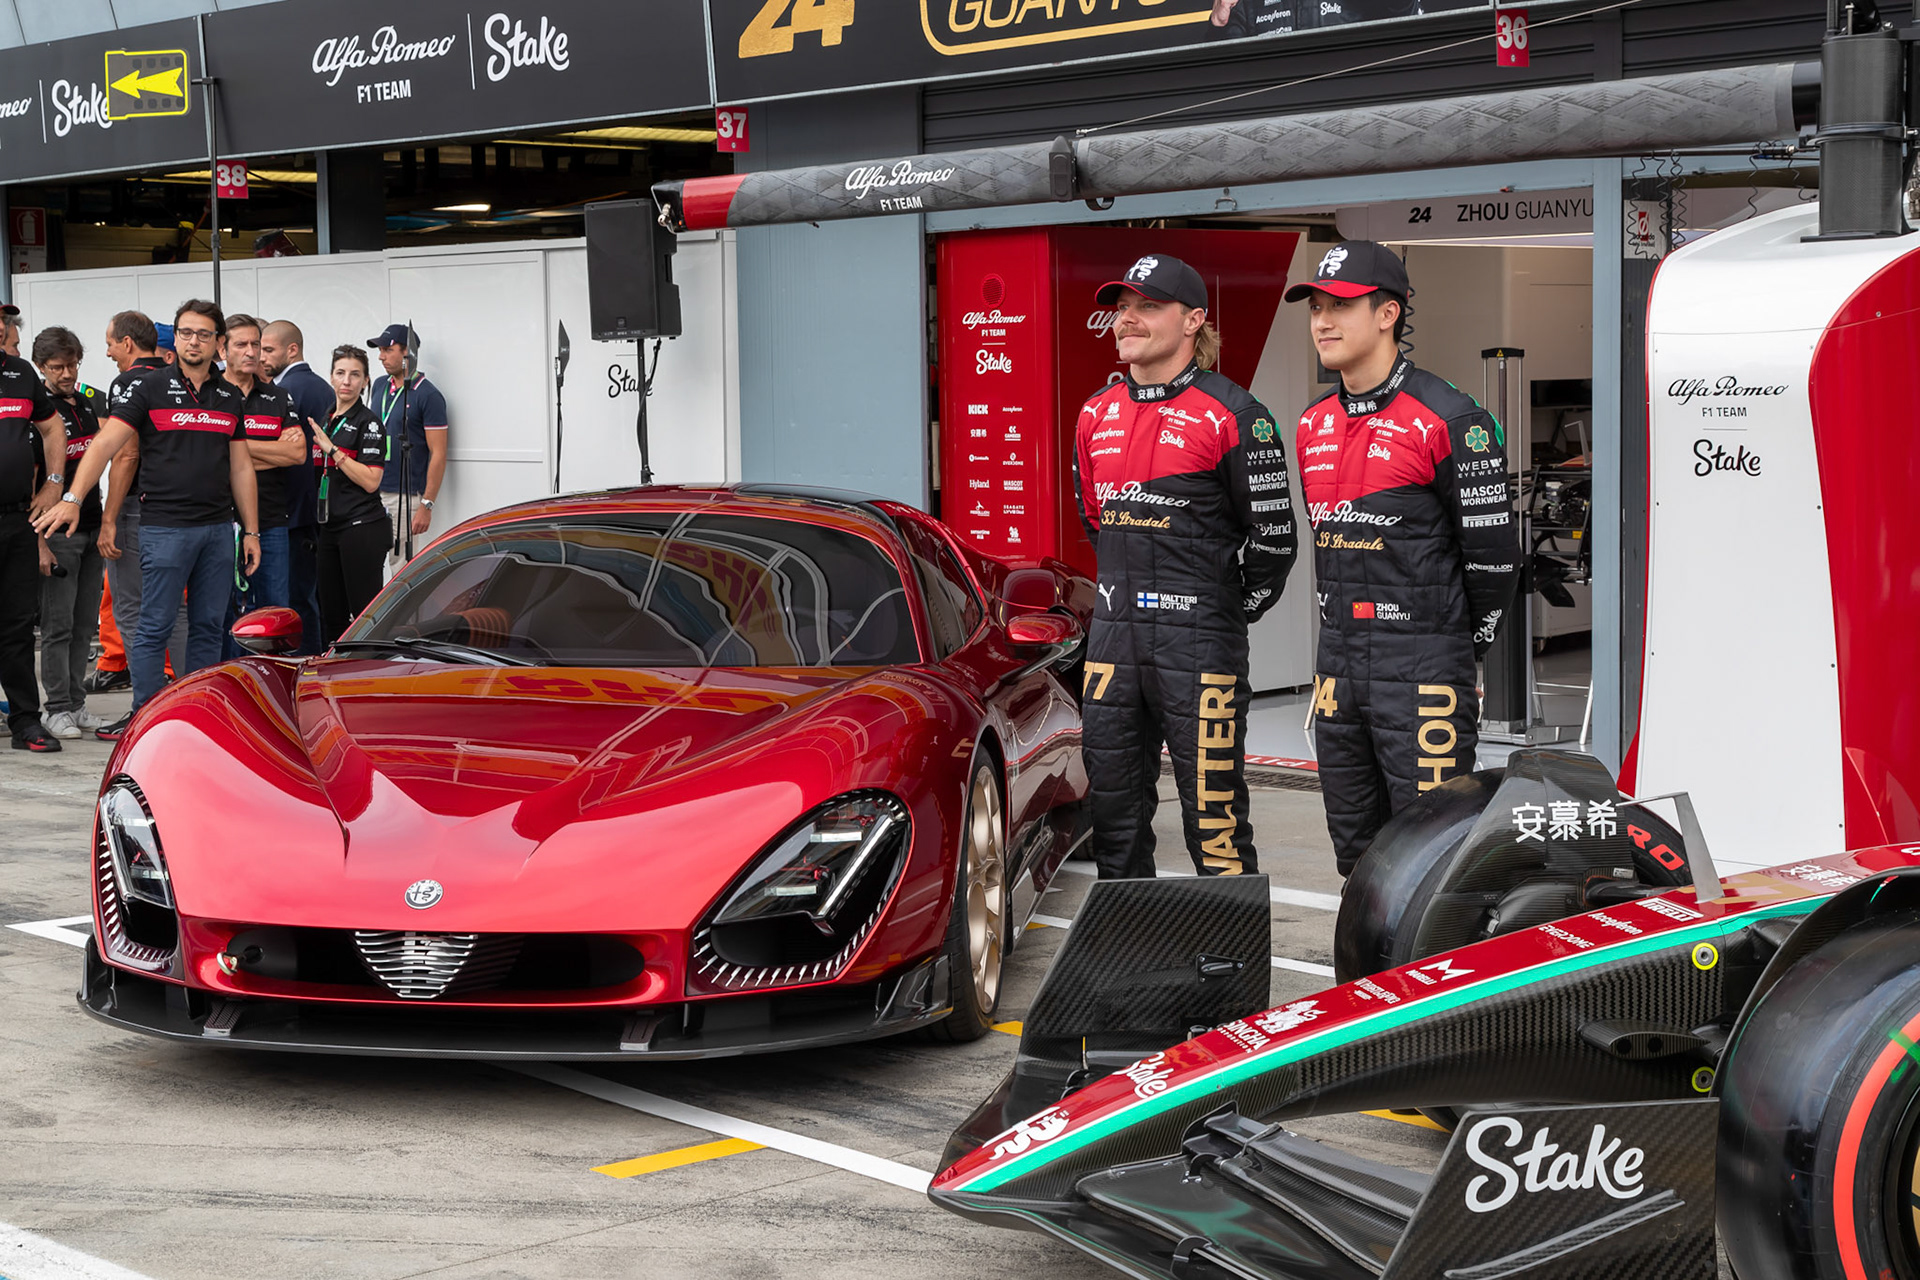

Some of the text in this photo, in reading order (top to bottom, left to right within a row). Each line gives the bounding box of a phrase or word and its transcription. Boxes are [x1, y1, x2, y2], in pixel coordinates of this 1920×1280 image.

[1497, 16, 1529, 50] 36
[312, 25, 456, 87] Alfa Romeo
[484, 13, 570, 82] Stake
[357, 79, 412, 104] F1 TEAM
[0, 97, 32, 119] meo
[717, 111, 748, 139] 37
[217, 164, 248, 188] 38
[845, 160, 956, 199] Alfa Romeo
[880, 195, 923, 212] F1 TEAM
[1408, 197, 1595, 224] 24 ZHOU GUANYU
[962, 309, 1026, 330] Alfa Romeo
[1087, 311, 1120, 338] Alf
[981, 328, 1006, 337] F1 TEAM
[976, 349, 1012, 375] Stake
[608, 363, 653, 399] Sta
[1667, 375, 1789, 406] Alfa Romeo
[171, 412, 231, 426] Alfa Romeo
[968, 404, 988, 415] KICK
[1702, 407, 1747, 418] F1 TEAM
[243, 418, 278, 430] Romeo
[1159, 430, 1185, 449] Stake
[1247, 457, 1285, 466] EYEWEA
[1367, 443, 1391, 461] Stake
[1693, 438, 1761, 477] Stake
[969, 479, 990, 490] Hyland
[1248, 470, 1287, 485] MASCOT
[1249, 481, 1288, 492] WORKWEAR
[1120, 480, 1190, 507] Romeo
[1460, 483, 1507, 499] MASCOT
[1460, 494, 1508, 507] WORKWEAR
[1251, 498, 1289, 512] PIRELLI
[1332, 500, 1403, 526] Romeo
[1115, 511, 1171, 529] Stradale
[1462, 512, 1509, 528] PIRELLI
[1330, 533, 1385, 550] Stradale
[1160, 593, 1198, 604] VALTTERI
[1160, 601, 1190, 611] BOTTAS
[1376, 603, 1400, 612] ZHOU
[1377, 611, 1411, 621] GUANYU
[1473, 608, 1503, 643] Stake
[1082, 660, 1115, 700] 77
[1417, 684, 1458, 792] HOU
[1511, 798, 1618, 843] 安慕希
[1627, 823, 1685, 871] RO
[1635, 897, 1704, 922] PIRELLI
[1223, 1019, 1271, 1050] SINGHA
[1111, 1050, 1174, 1099] Stake
[1464, 1116, 1645, 1213] Stake
